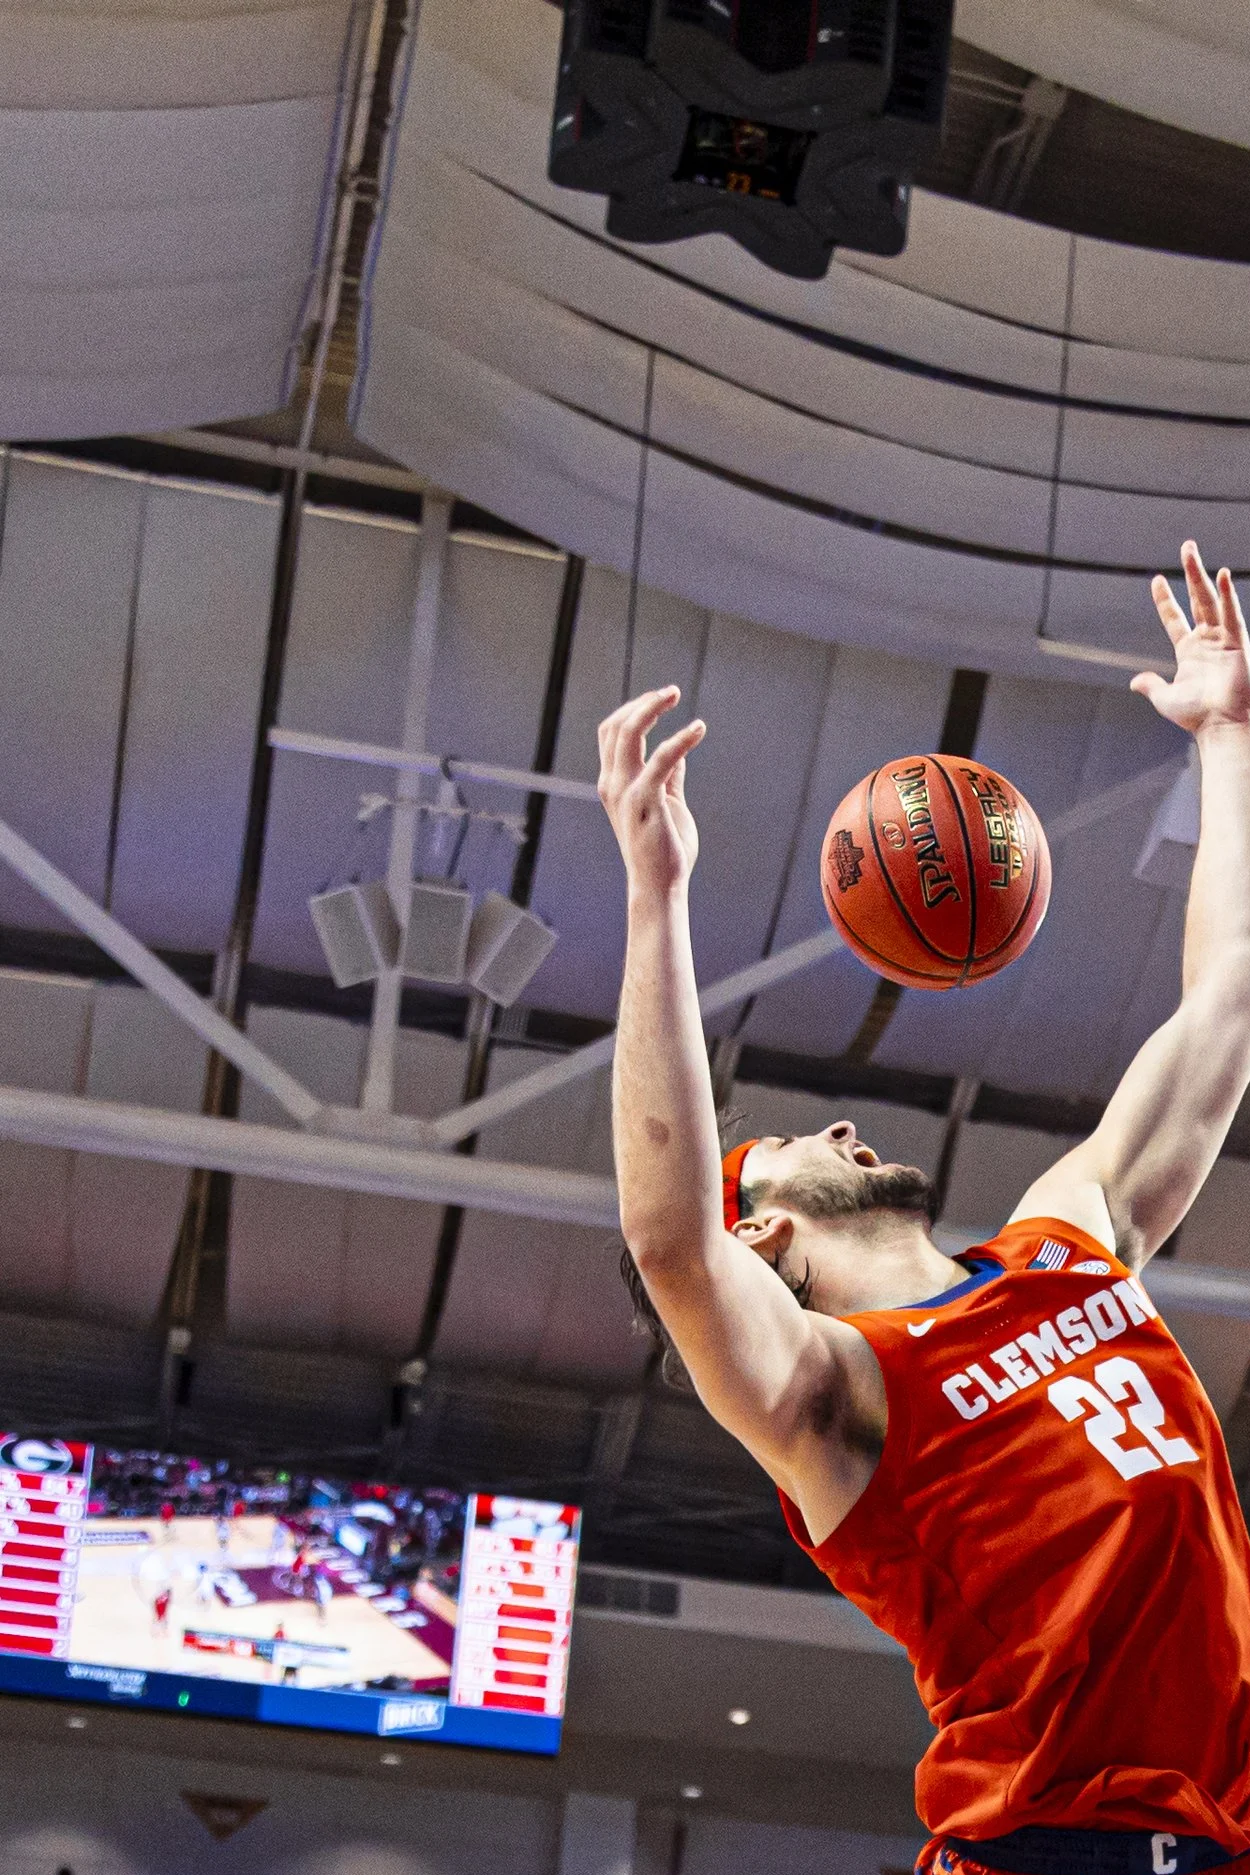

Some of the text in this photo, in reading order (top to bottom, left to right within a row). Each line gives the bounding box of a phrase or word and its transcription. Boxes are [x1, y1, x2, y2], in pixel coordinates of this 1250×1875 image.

[891, 763, 962, 909] SPALDING
[959, 767, 1009, 889] LEGACY
[941, 1277, 1158, 1421] CLEMSON
[1047, 1356, 1200, 1481] 22
[1151, 1832, 1178, 1875] C
